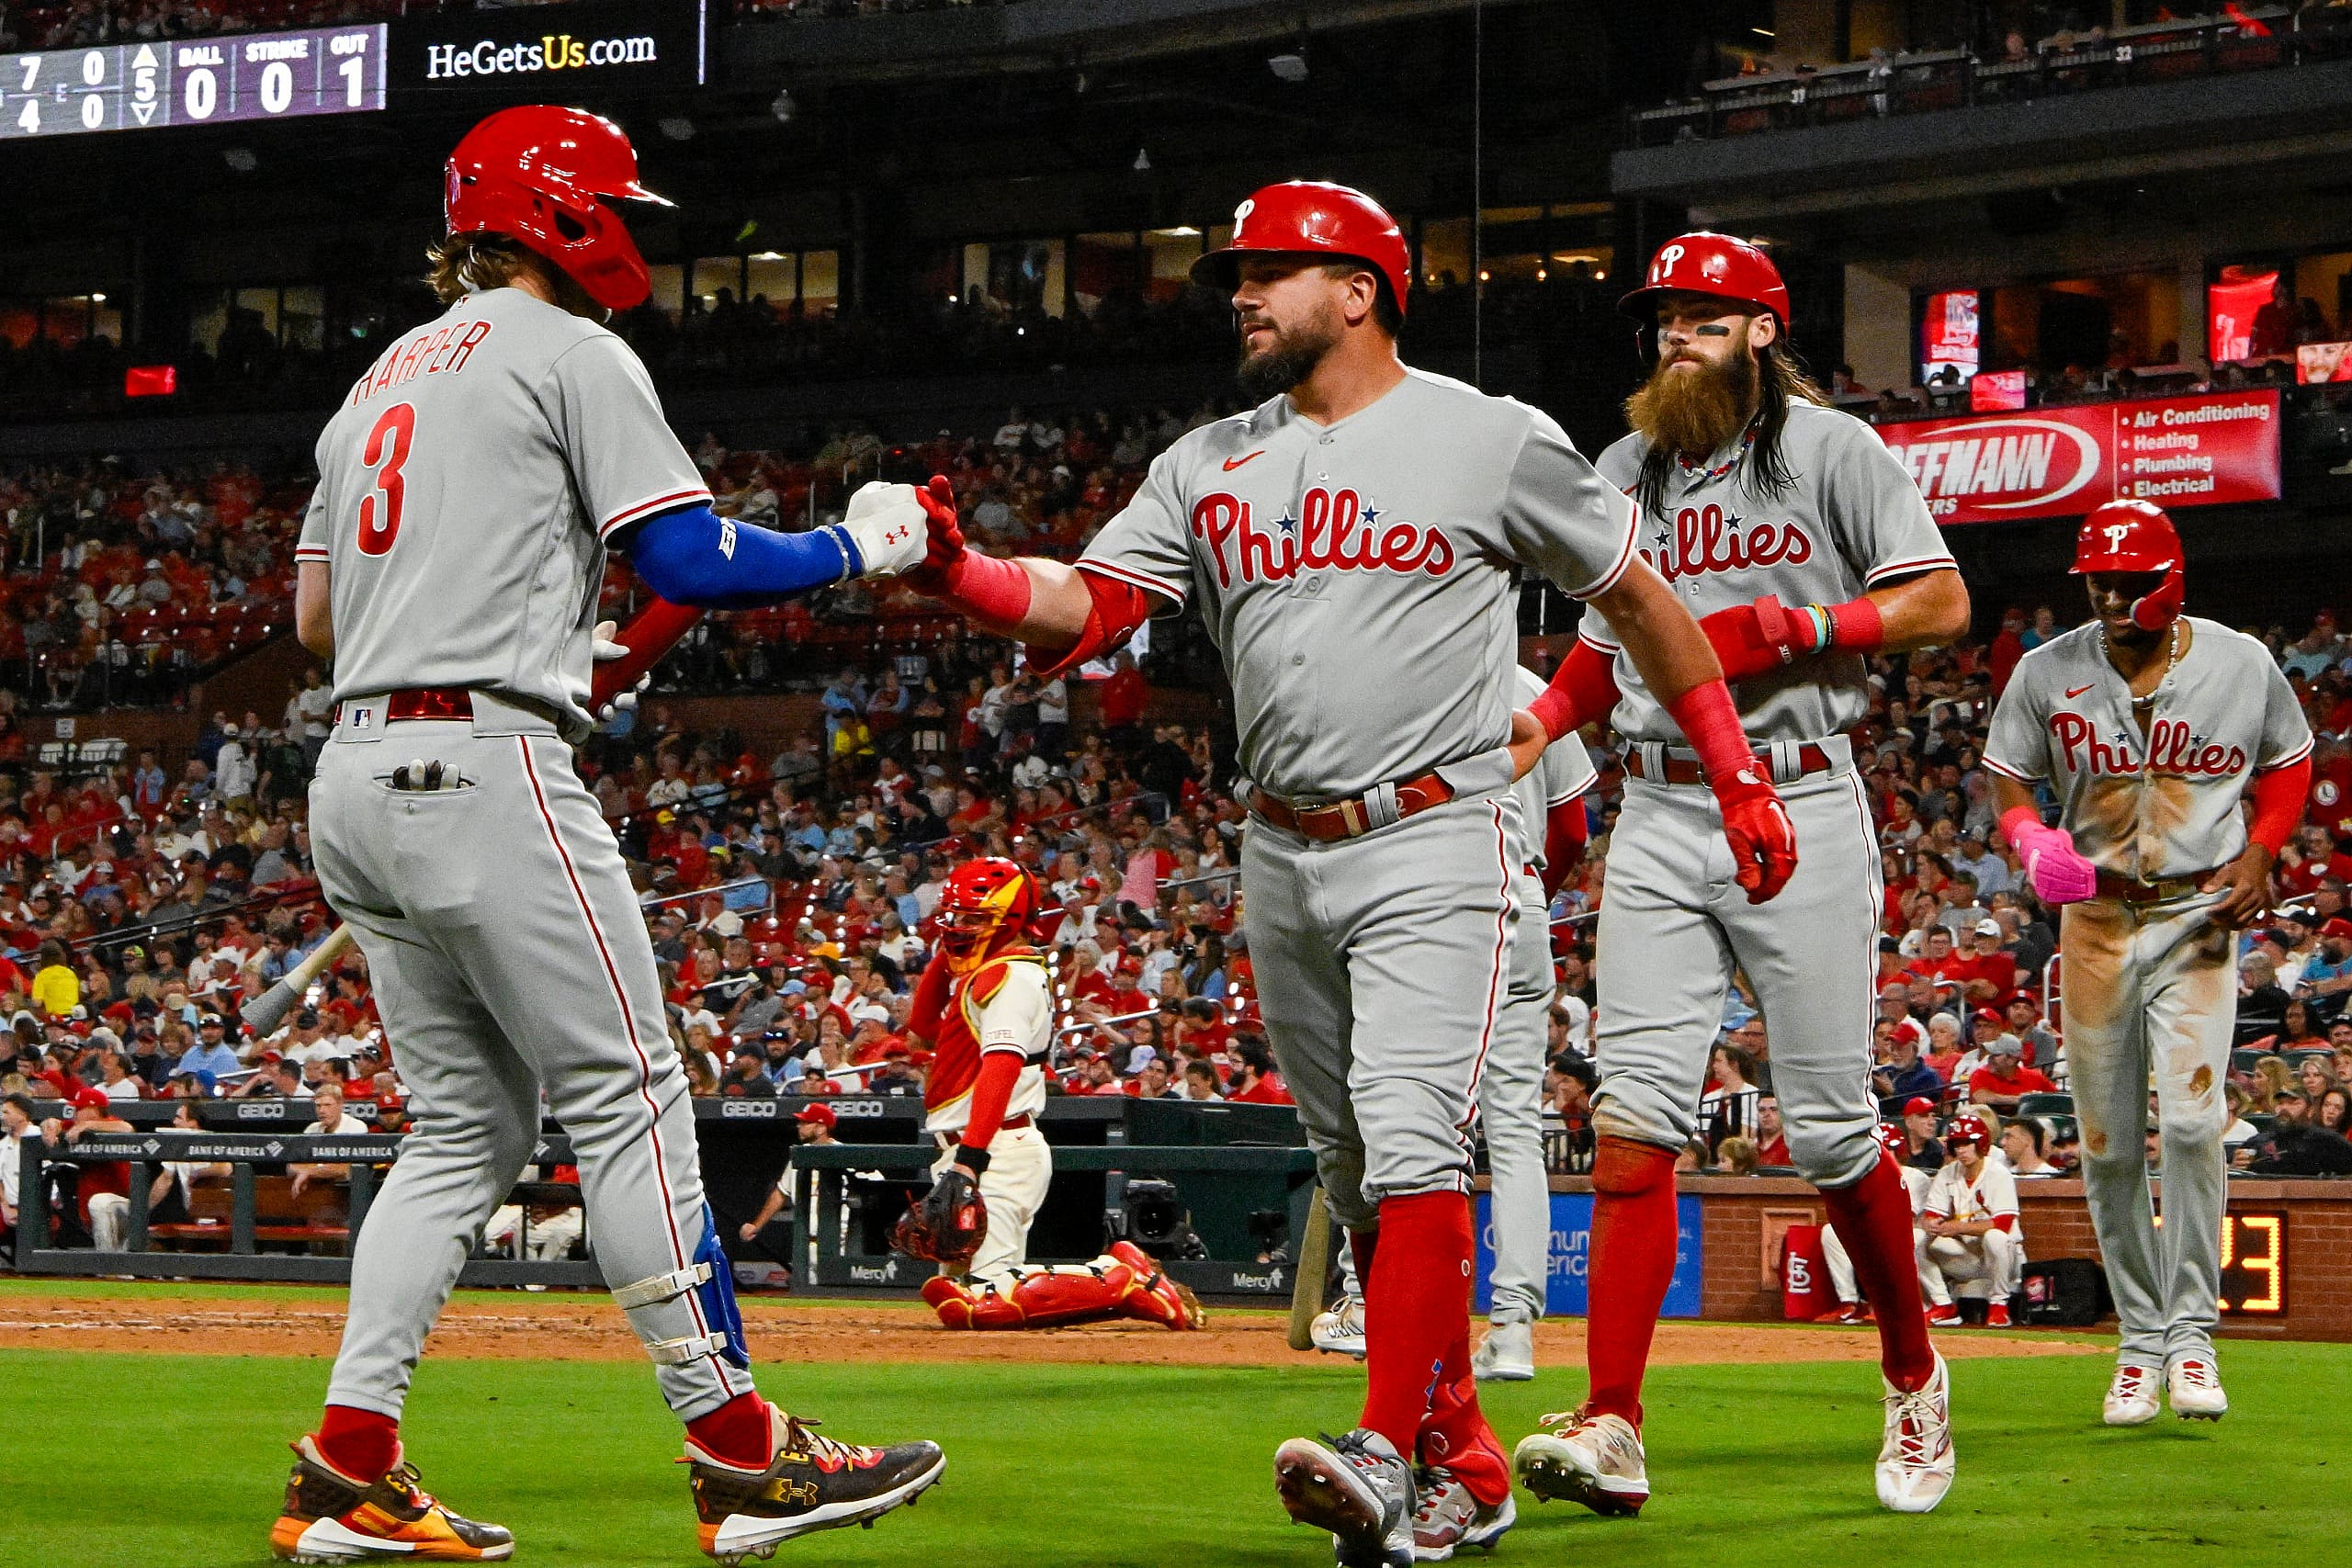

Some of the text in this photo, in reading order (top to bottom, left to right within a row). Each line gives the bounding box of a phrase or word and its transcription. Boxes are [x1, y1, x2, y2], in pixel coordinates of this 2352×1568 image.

[178, 46, 223, 67] BALL
[245, 39, 309, 62] STRIKE
[330, 34, 368, 55] OUT
[426, 35, 657, 79] HeGetsUs.com
[19, 56, 41, 90] 7
[83, 51, 105, 85] 0
[339, 57, 363, 107] 1
[56, 84, 67, 102] E
[135, 68, 155, 101] 5
[185, 68, 216, 119] 0
[260, 62, 292, 113] 0
[17, 99, 40, 133] 4
[82, 94, 104, 129] 0
[1660, 244, 1685, 277] P
[352, 321, 492, 407] HARPER
[2133, 402, 2270, 428] Air Conditioning
[2133, 432, 2199, 451] Heating
[1888, 433, 2056, 497] FFMANN
[2133, 453, 2212, 474] Plumbing
[356, 400, 417, 558] 3
[2134, 475, 2215, 497] Electrical
[1927, 497, 1958, 515] ERS
[1192, 486, 1456, 592] Phillies
[1637, 502, 1812, 584] illies
[2049, 711, 2246, 776] Phillies
[237, 1103, 285, 1119] GEICO
[343, 1103, 378, 1118] EICO
[721, 1101, 777, 1118] GEICO
[188, 1145, 211, 1156] BANK
[226, 1145, 265, 1156] AMERICA
[311, 1146, 337, 1156] BANK
[352, 1146, 392, 1157] AMERICA
[851, 1265, 887, 1283] Mercy
[1233, 1273, 1272, 1291] Mercy
